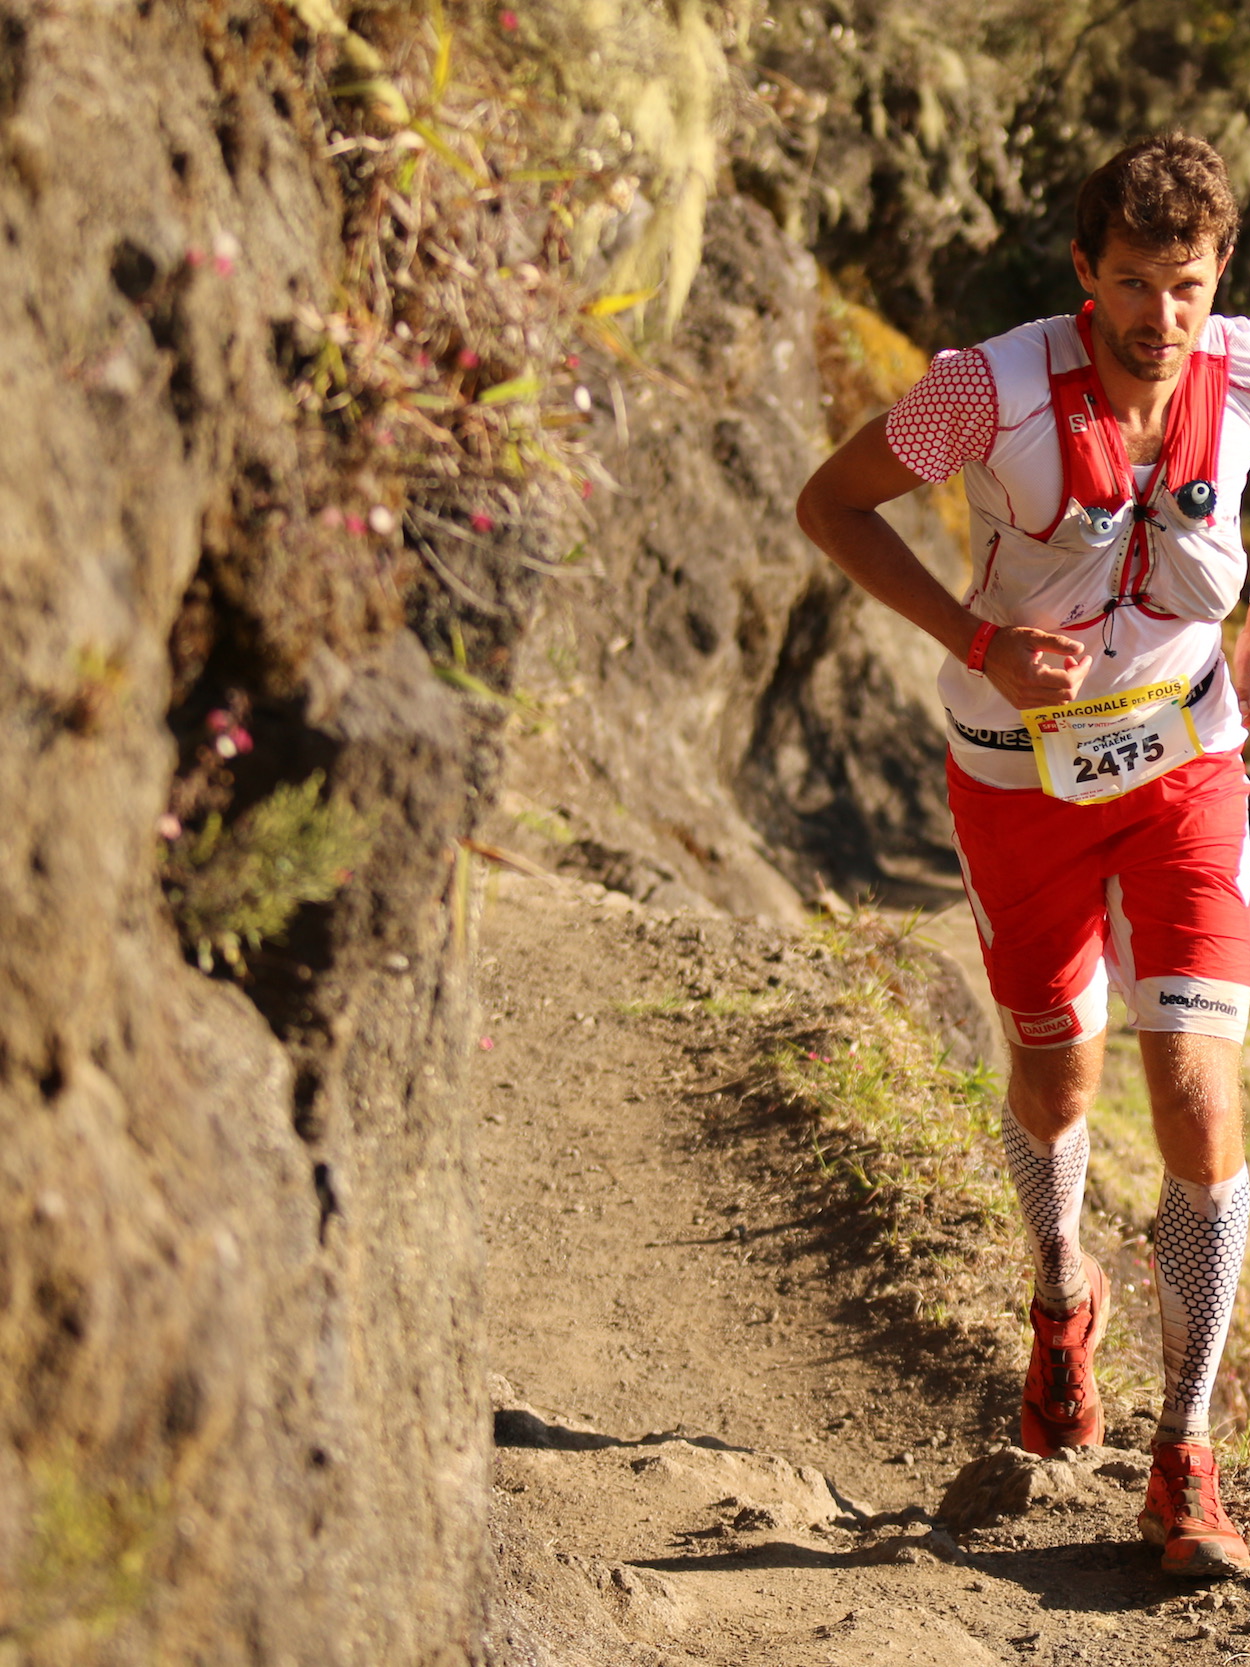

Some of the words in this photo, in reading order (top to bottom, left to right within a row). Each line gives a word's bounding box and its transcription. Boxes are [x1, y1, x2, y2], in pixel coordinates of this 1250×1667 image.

[1051, 699, 1128, 719] DIAGONALE
[1131, 697, 1146, 705] DES
[1147, 682, 1182, 700] FOUS
[1073, 733, 1164, 783] 2475
